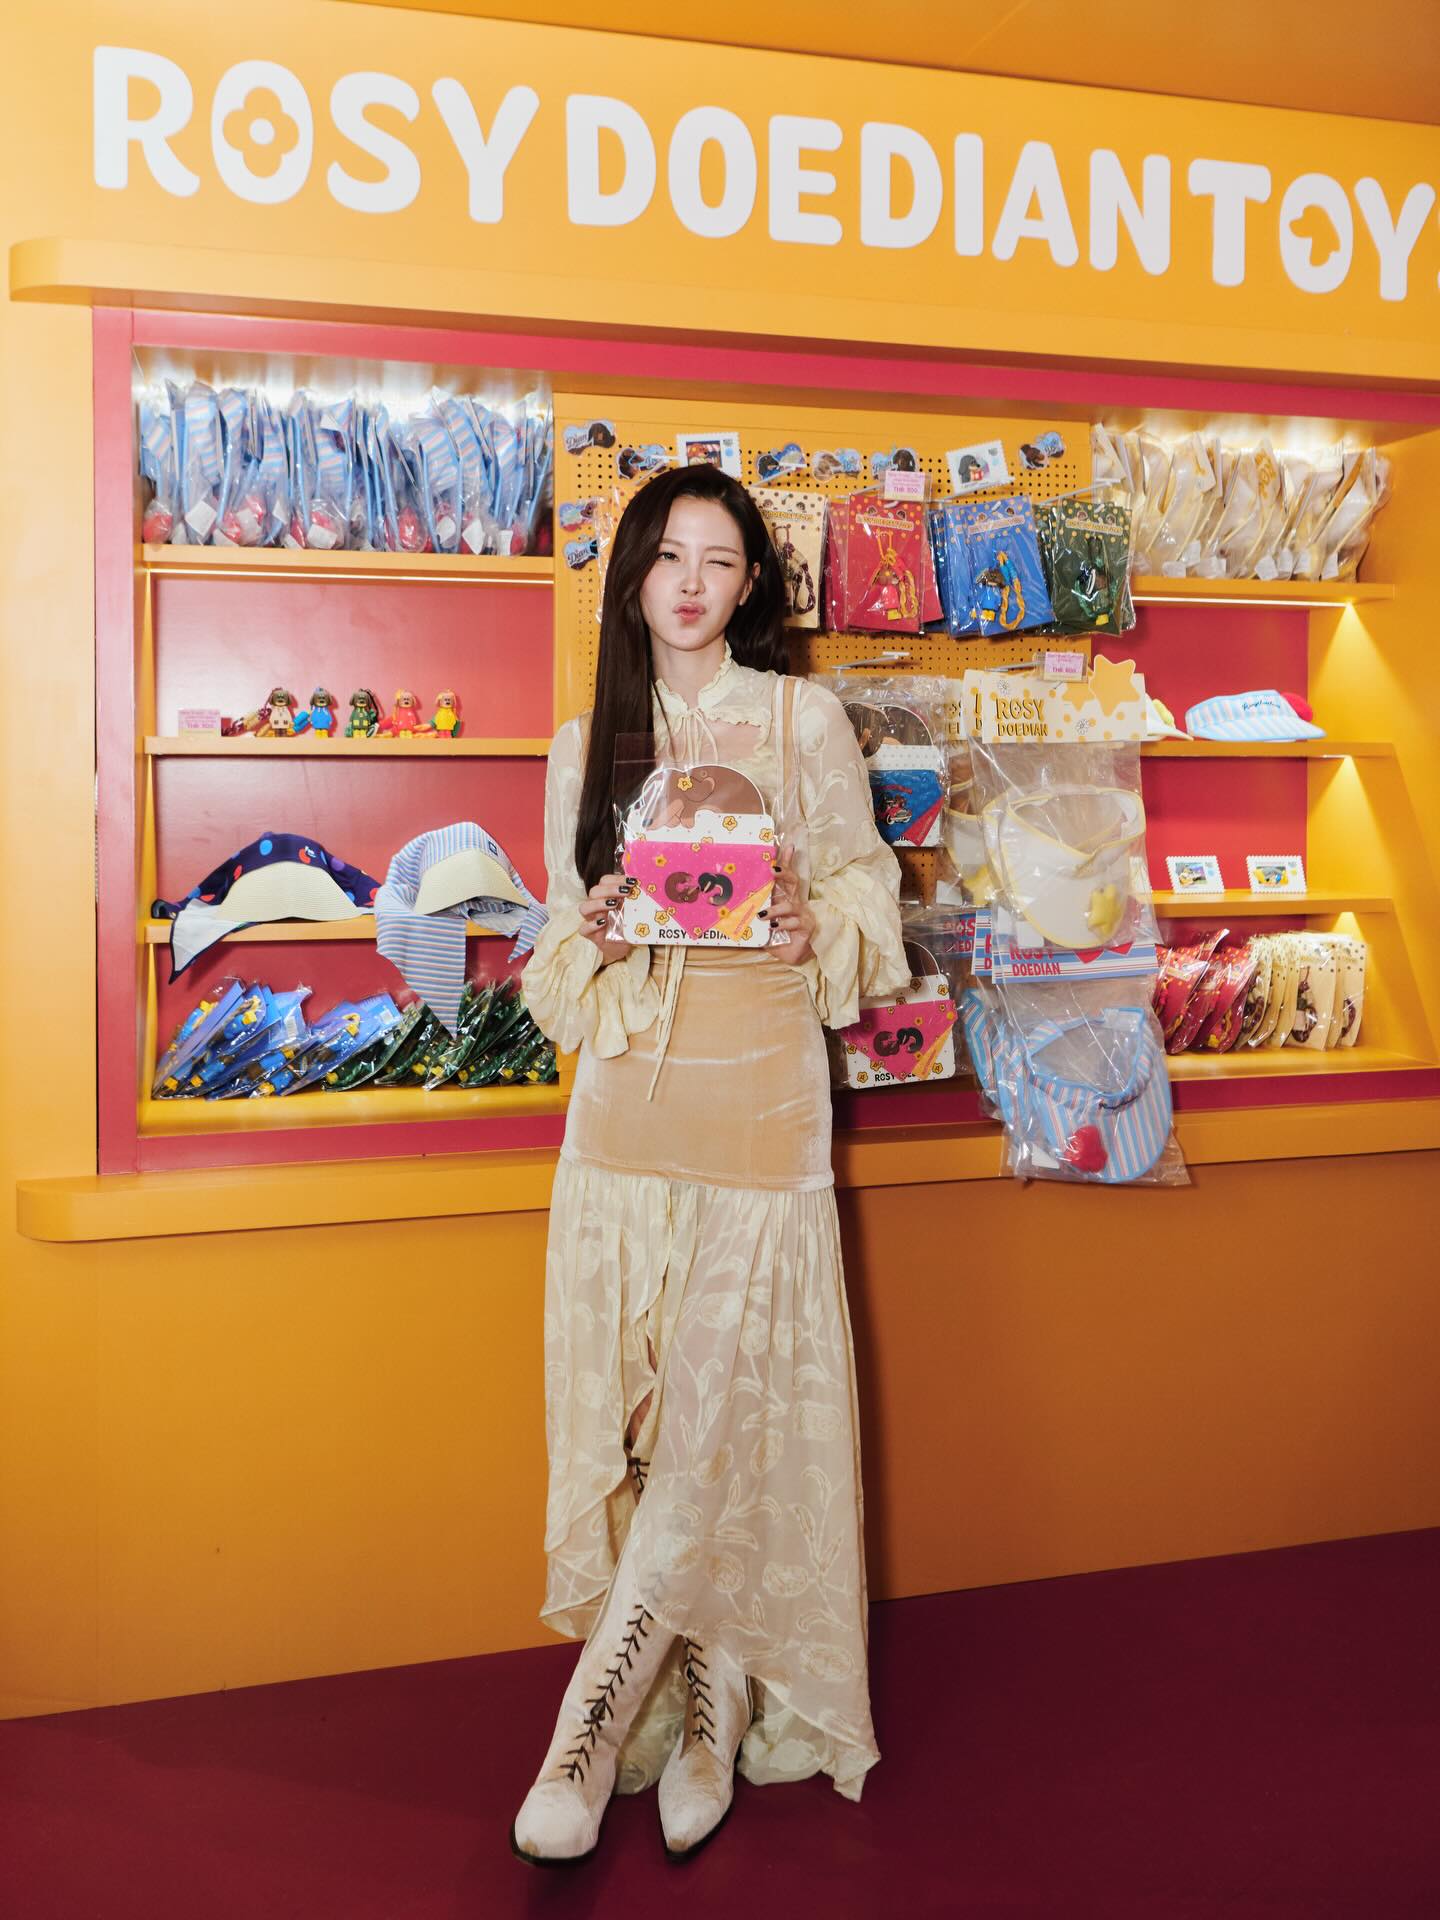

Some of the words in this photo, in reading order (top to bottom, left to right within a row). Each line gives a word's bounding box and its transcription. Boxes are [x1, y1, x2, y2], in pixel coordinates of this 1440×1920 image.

[93, 45, 540, 224] ROSY
[1188, 158, 1440, 301] TOY
[995, 697, 1045, 721] ROSY
[997, 722, 1048, 737] DOEDIAN
[658, 928, 687, 939] ROSY
[1012, 962, 1061, 976] DOEDIAN
[874, 1072, 895, 1082] ROSY
